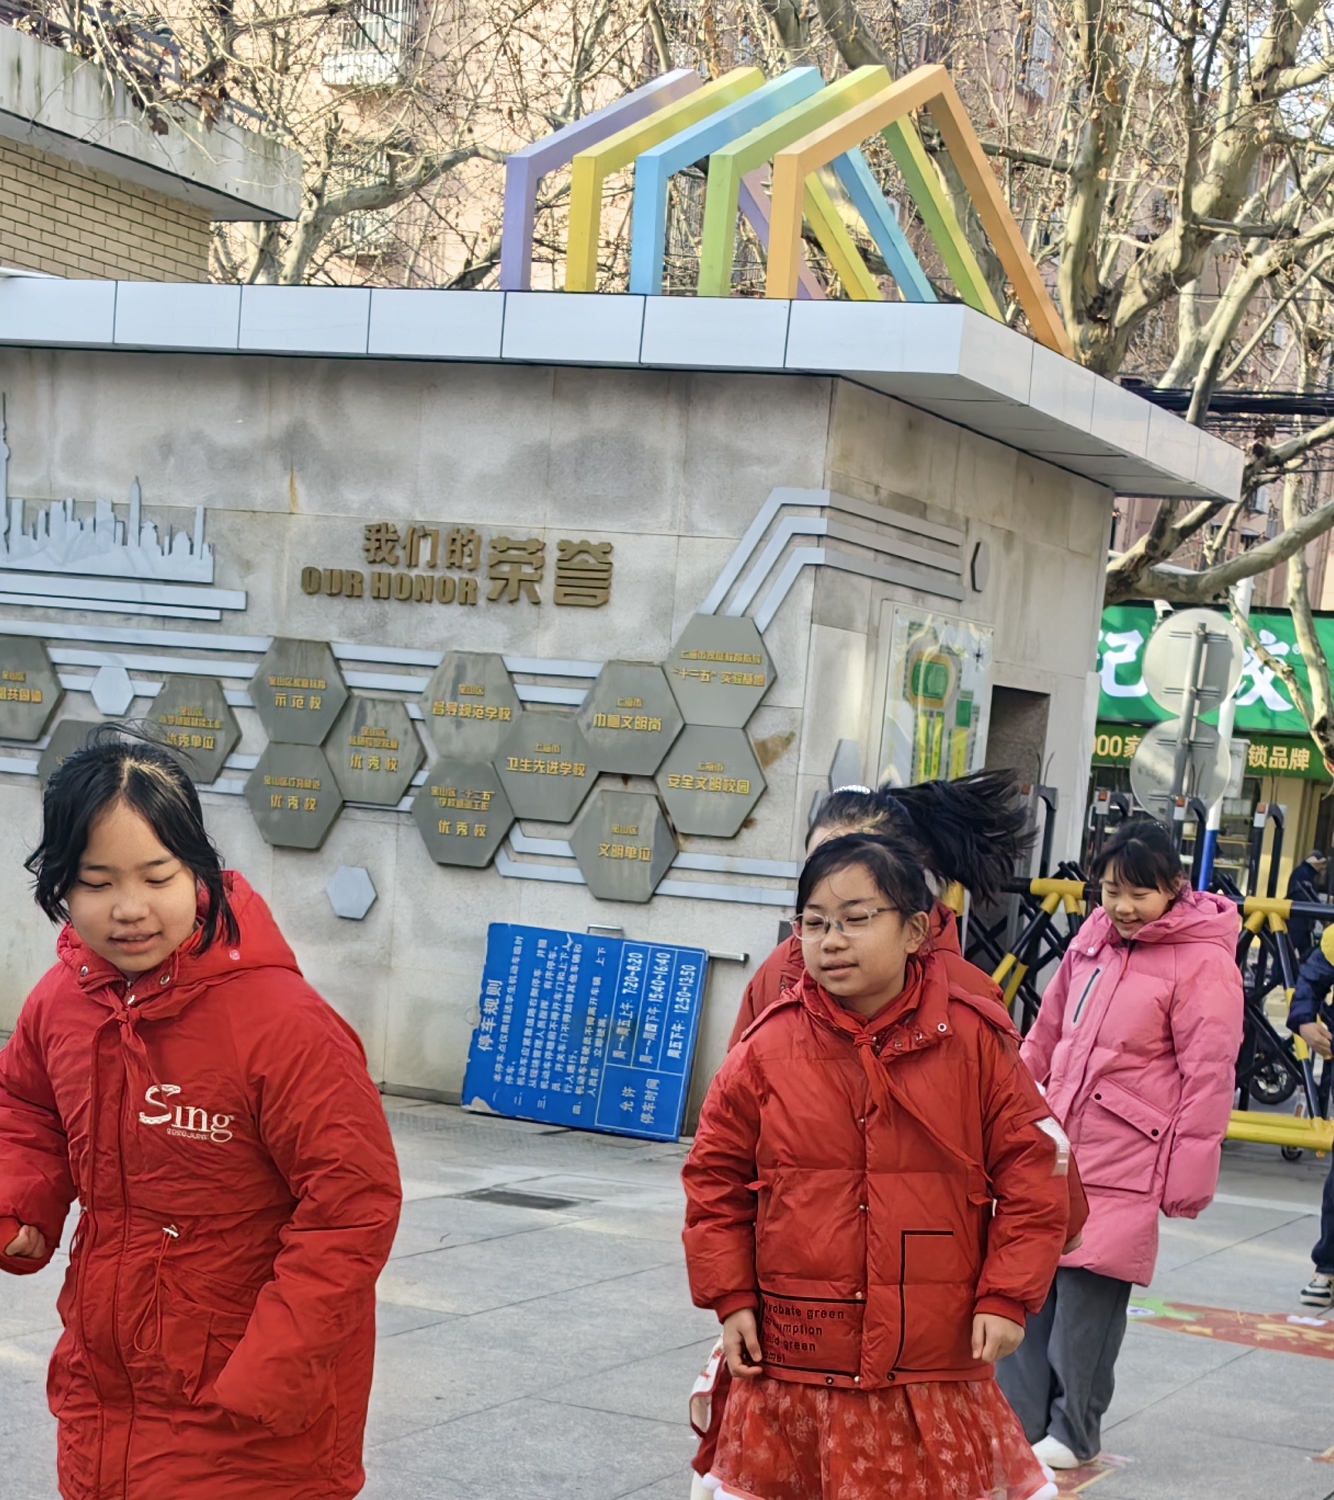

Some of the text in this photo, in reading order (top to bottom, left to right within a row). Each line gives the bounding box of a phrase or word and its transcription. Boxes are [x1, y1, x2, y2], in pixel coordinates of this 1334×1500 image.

[300, 566, 478, 606] OUR HONOR
[486, 535, 613, 607] 荣誉
[506, 756, 586, 777] 卫生先进学校
[1248, 744, 1311, 771] 锁品牌
[667, 773, 750, 795] 安全文明校园
[598, 843, 651, 862] 文明单位
[477, 978, 503, 1052] 停车规则
[139, 1084, 235, 1143] Sing
[640, 1079, 660, 1125] 停车时间
[806, 1308, 845, 1320] green
